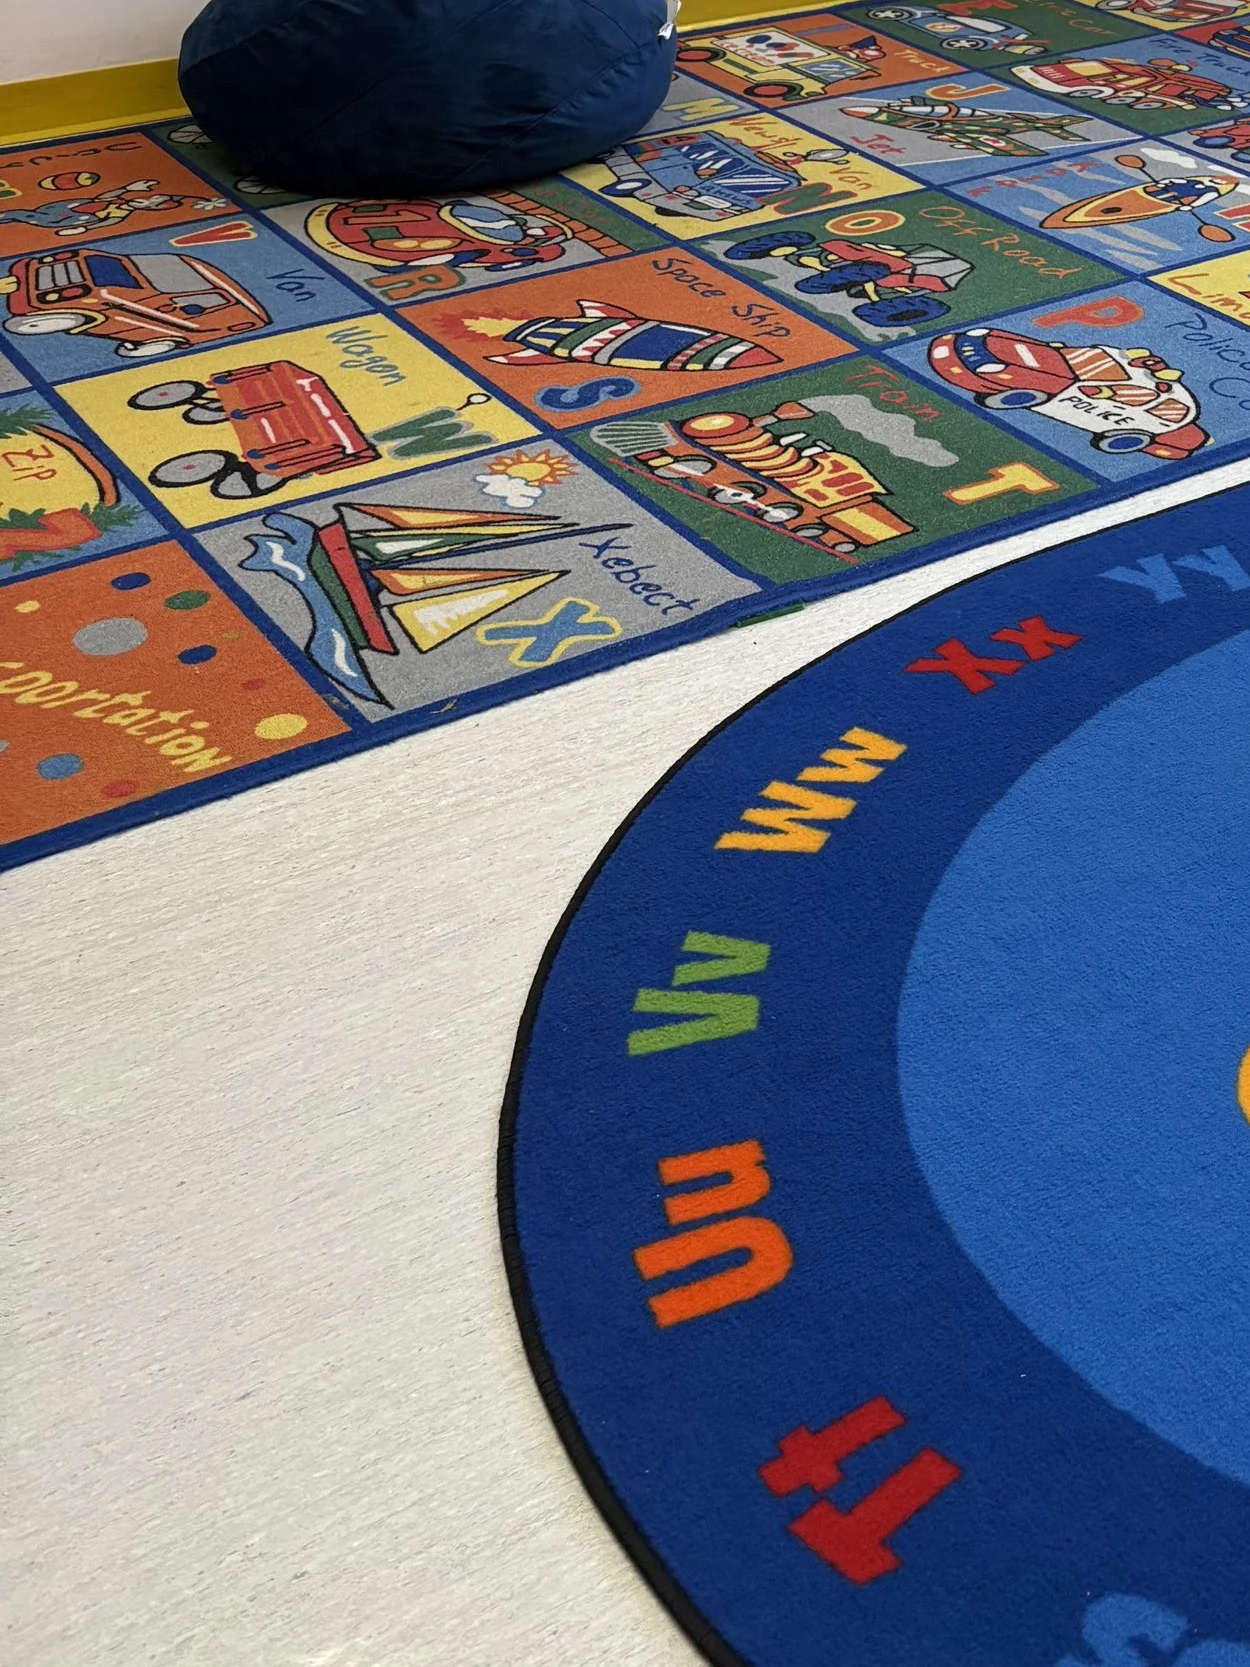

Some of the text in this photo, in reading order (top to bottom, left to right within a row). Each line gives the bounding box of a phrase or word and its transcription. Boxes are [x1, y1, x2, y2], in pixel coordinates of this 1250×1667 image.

[894, 48, 951, 73] Truck
[1148, 36, 1190, 54] Fire
[660, 96, 743, 123] M
[925, 82, 1010, 101] J
[850, 134, 908, 155] Jet
[829, 166, 873, 190] Van
[168, 220, 258, 248] V
[824, 208, 907, 237] O
[919, 206, 1083, 280] Off Road
[265, 266, 319, 304] Van
[363, 264, 467, 301] R
[649, 256, 792, 340] Space Ship
[1029, 295, 1146, 330] P
[325, 324, 408, 388] Wagon
[532, 375, 642, 413] S
[843, 364, 942, 424] Train
[1057, 393, 1137, 429] POLICE
[364, 404, 501, 462] W
[2, 450, 57, 482] ZIP
[942, 460, 1061, 506] T
[578, 534, 702, 618] Xebect
[476, 596, 623, 667] X
[904, 613, 1084, 695] Xx
[713, 724, 909, 854] Ww
[625, 930, 773, 1058] Vv
[633, 1138, 794, 1330] Uu
[757, 1396, 966, 1586] Tt
